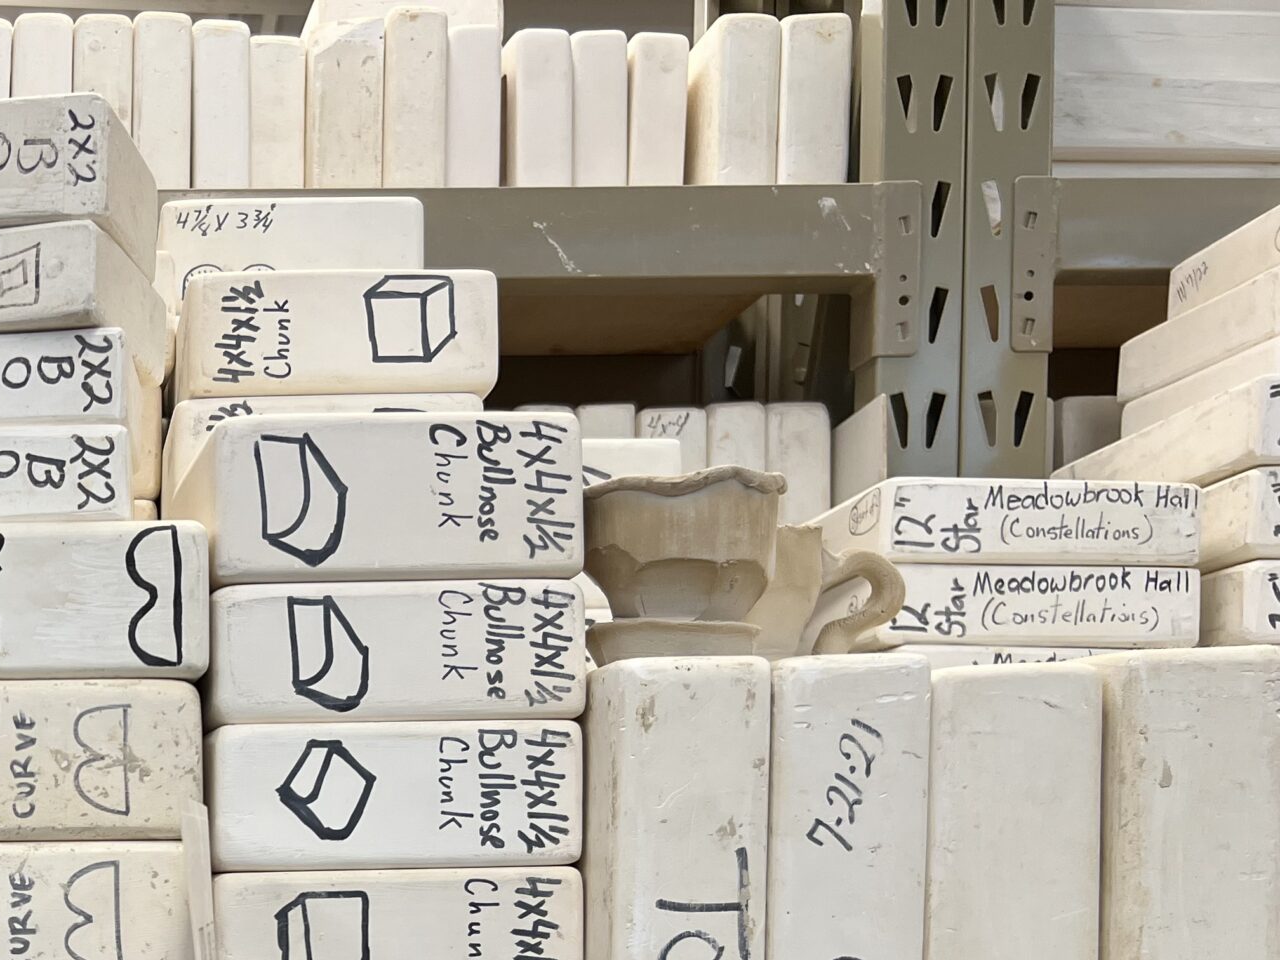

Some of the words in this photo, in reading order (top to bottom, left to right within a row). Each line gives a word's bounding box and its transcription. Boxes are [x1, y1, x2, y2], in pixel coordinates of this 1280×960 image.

[263, 299, 291, 378] Chunk
[429, 423, 474, 528] Chunk
[475, 418, 517, 543] Bullnose
[984, 481, 1144, 511] Meadowbrook
[1155, 484, 1198, 510] Hall
[939, 497, 982, 553] Star
[1000, 510, 1154, 546] (Constellations)
[933, 577, 968, 638] Star
[972, 565, 1132, 597] Meadowbrook
[1144, 570, 1189, 593] Hall
[980, 594, 1160, 632] (Constellations)
[438, 589, 478, 681] Chunk
[477, 581, 527, 700] Bullnose
[8, 710, 37, 818] CURVE
[438, 736, 475, 831] Chunk
[477, 727, 519, 849] Bullnose
